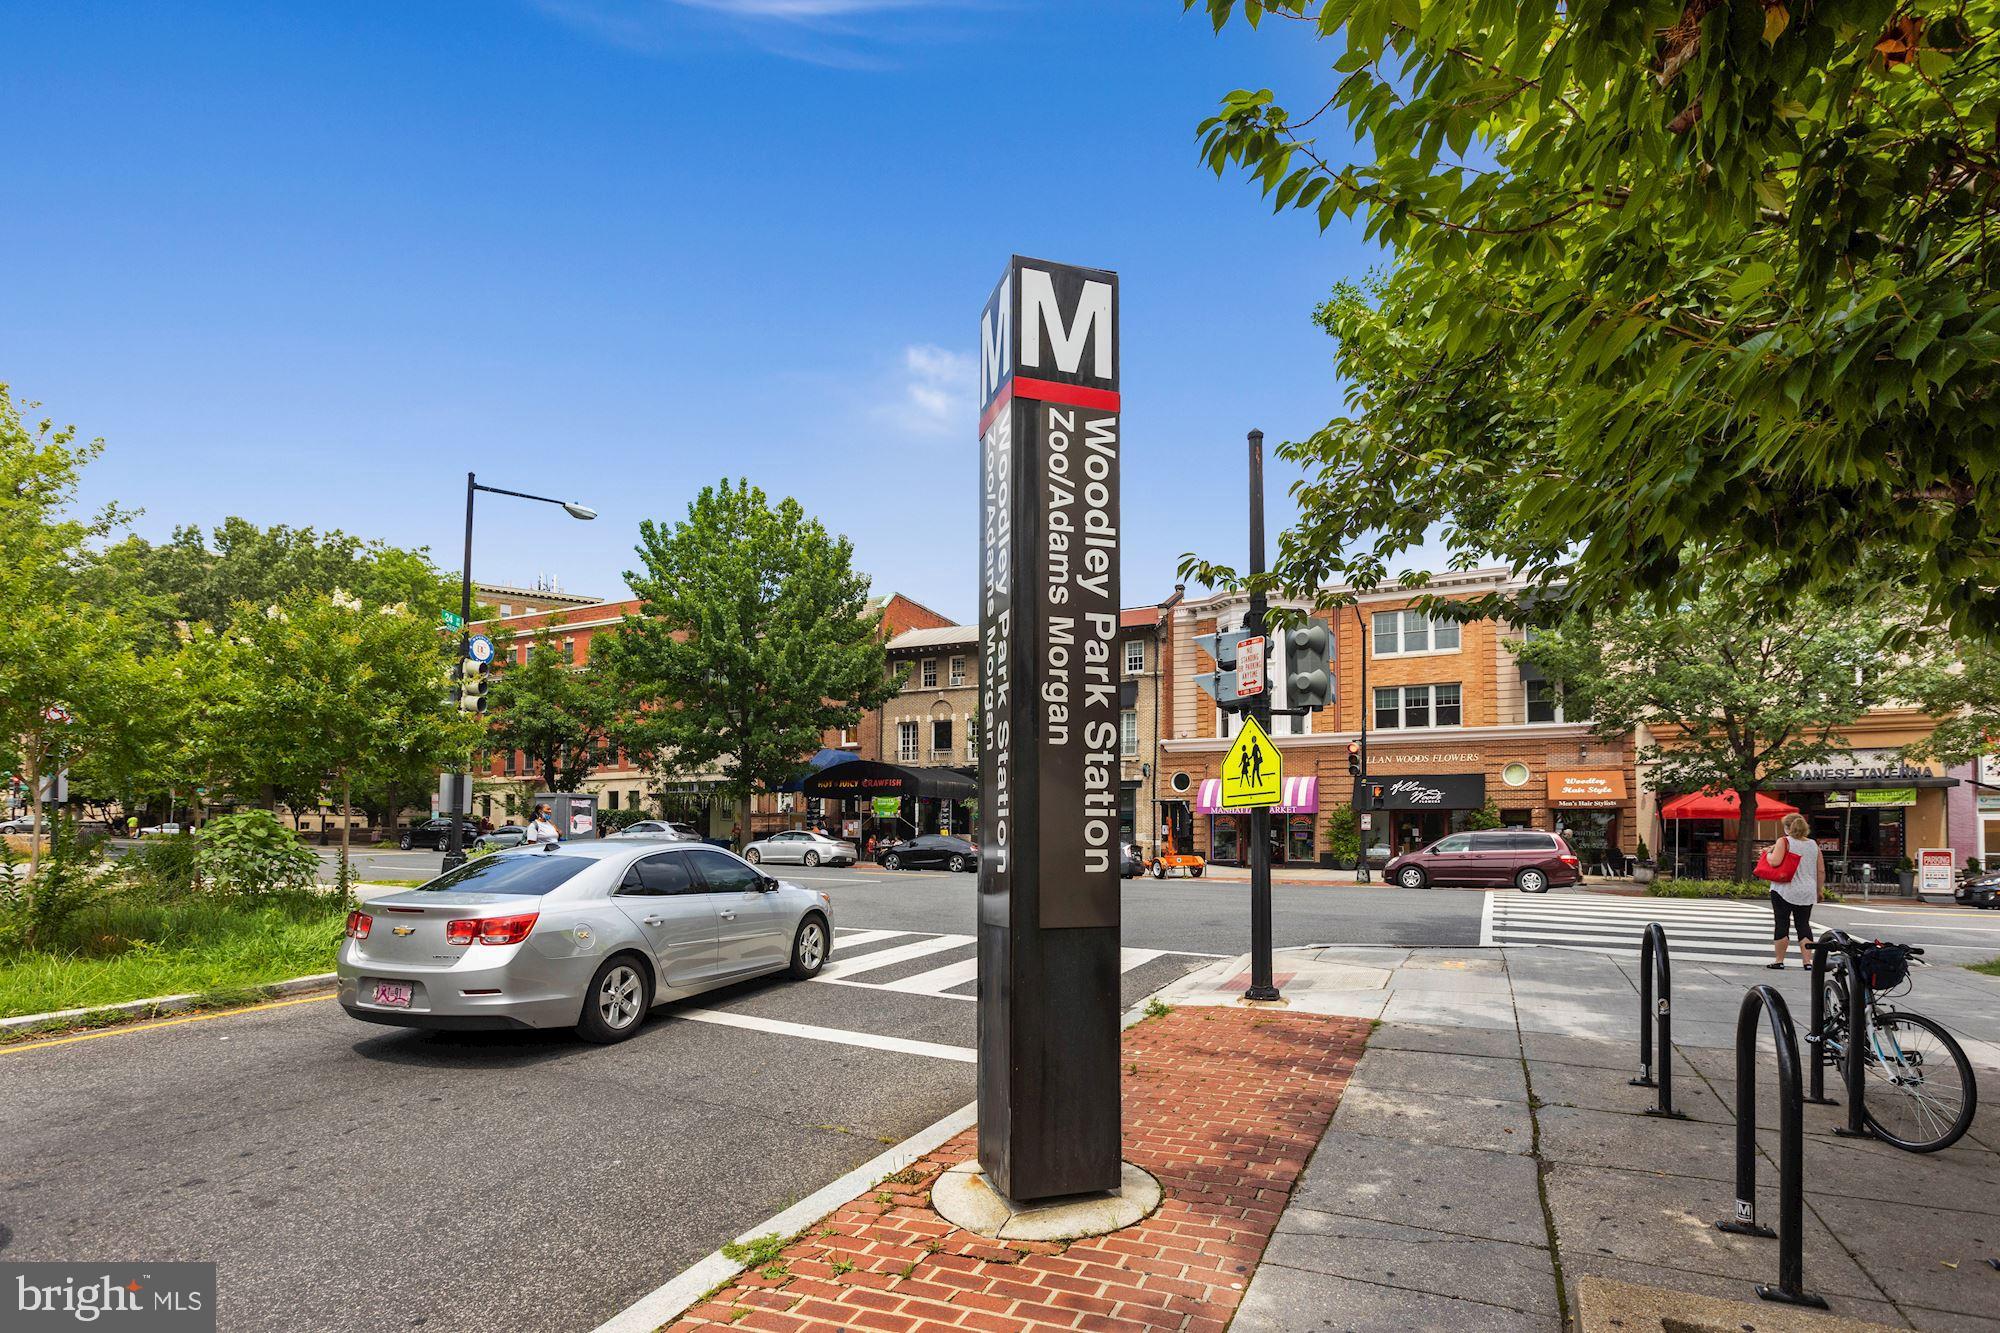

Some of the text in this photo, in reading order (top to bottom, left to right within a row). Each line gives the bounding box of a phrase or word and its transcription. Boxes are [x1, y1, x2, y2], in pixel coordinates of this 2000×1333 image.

[1021, 267, 1112, 379] M
[981, 274, 1010, 409] M
[1041, 407, 1076, 745] Zoo/Adams Morgan
[995, 405, 1011, 873] Woodley Park Station
[1076, 417, 1117, 873] Woodley Park Station
[984, 625, 996, 750] Morgan
[1364, 753, 1480, 764] LLAN WOODS FLOWERS
[1860, 767, 1934, 780] TAVERNA
[817, 778, 902, 788] HOT JUICY CRAWFISH
[1390, 780, 1427, 796] Allan
[1561, 786, 1613, 795] Hair Style
[1269, 806, 1297, 814] ARKET
[1819, 843, 1839, 851] OPEN
[1923, 855, 1950, 865] PARKING
[1738, 1203, 1751, 1216] M
